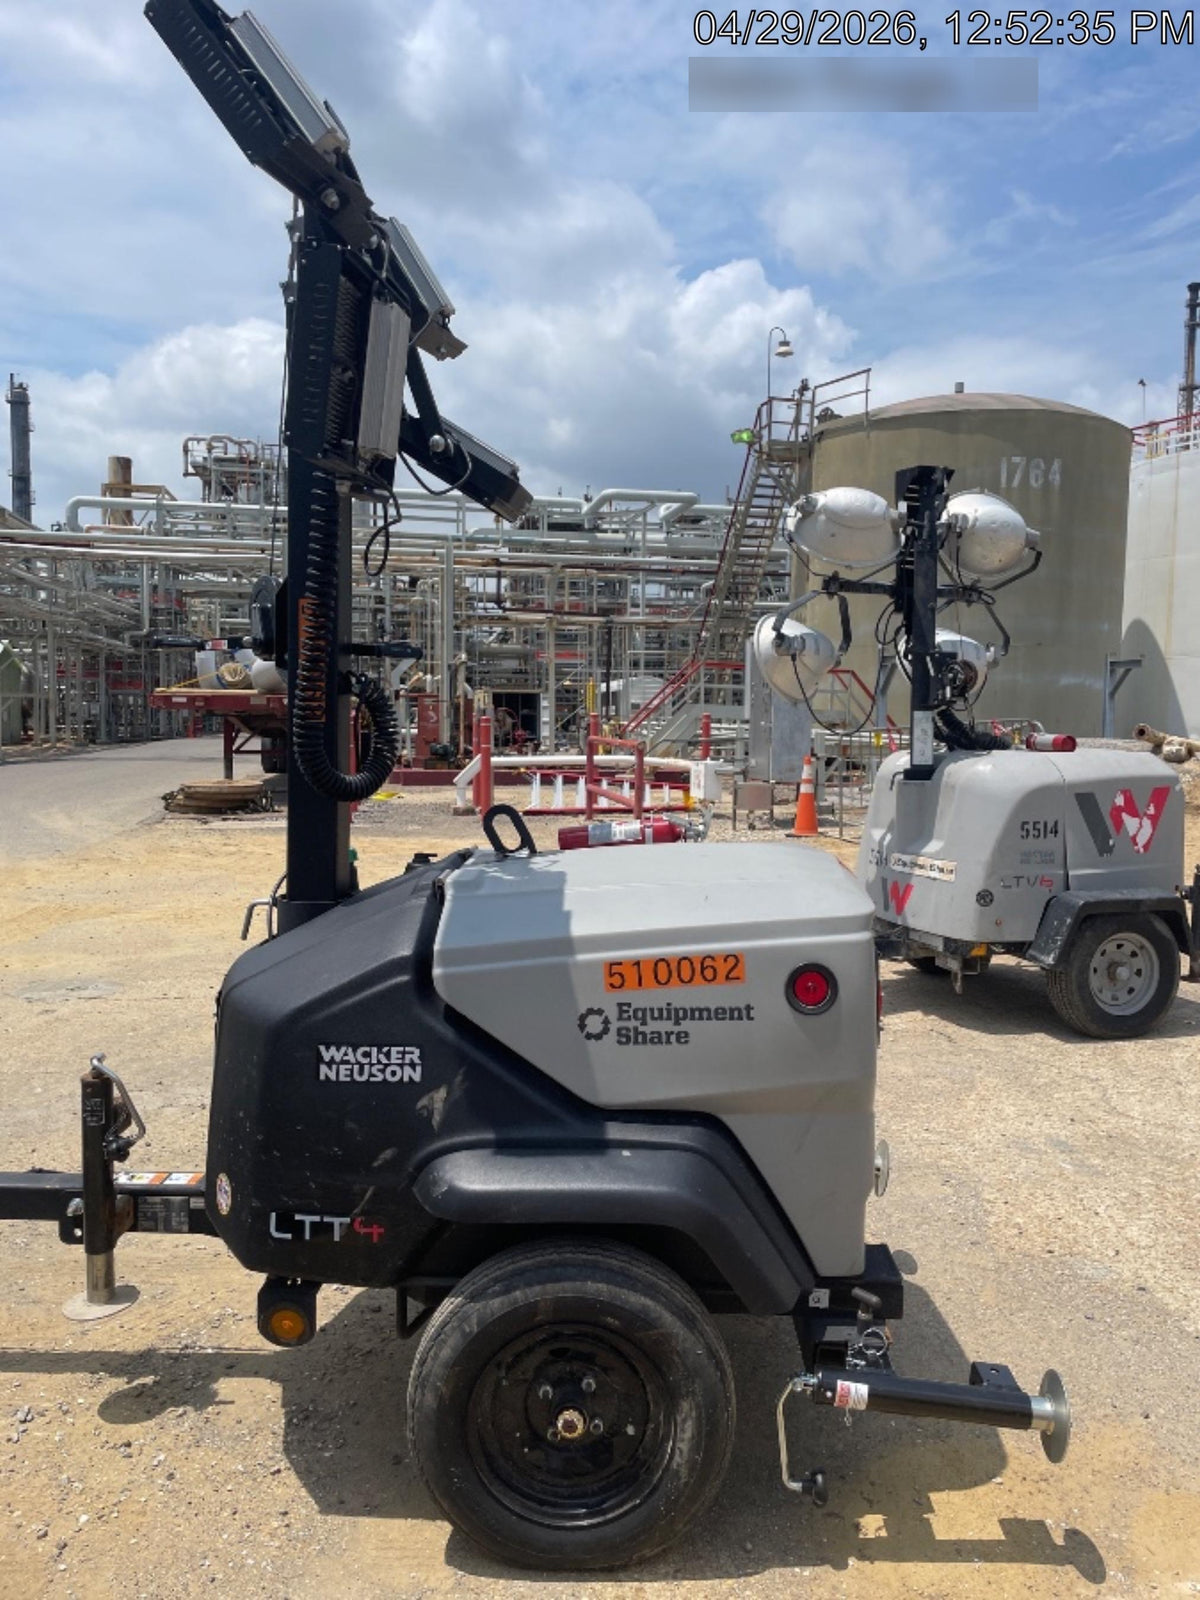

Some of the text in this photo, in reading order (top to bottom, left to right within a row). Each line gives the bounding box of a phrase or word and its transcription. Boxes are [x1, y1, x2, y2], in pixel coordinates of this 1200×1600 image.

[1000, 456, 1062, 488] 1764
[1020, 819, 1059, 840] 5514
[608, 954, 741, 989] 510062
[616, 1002, 755, 1026] Equipment
[616, 1026, 690, 1046] Share
[318, 1045, 422, 1064] WACKER
[319, 1064, 422, 1083] NEUSON
[269, 1212, 385, 1243] LTT4
